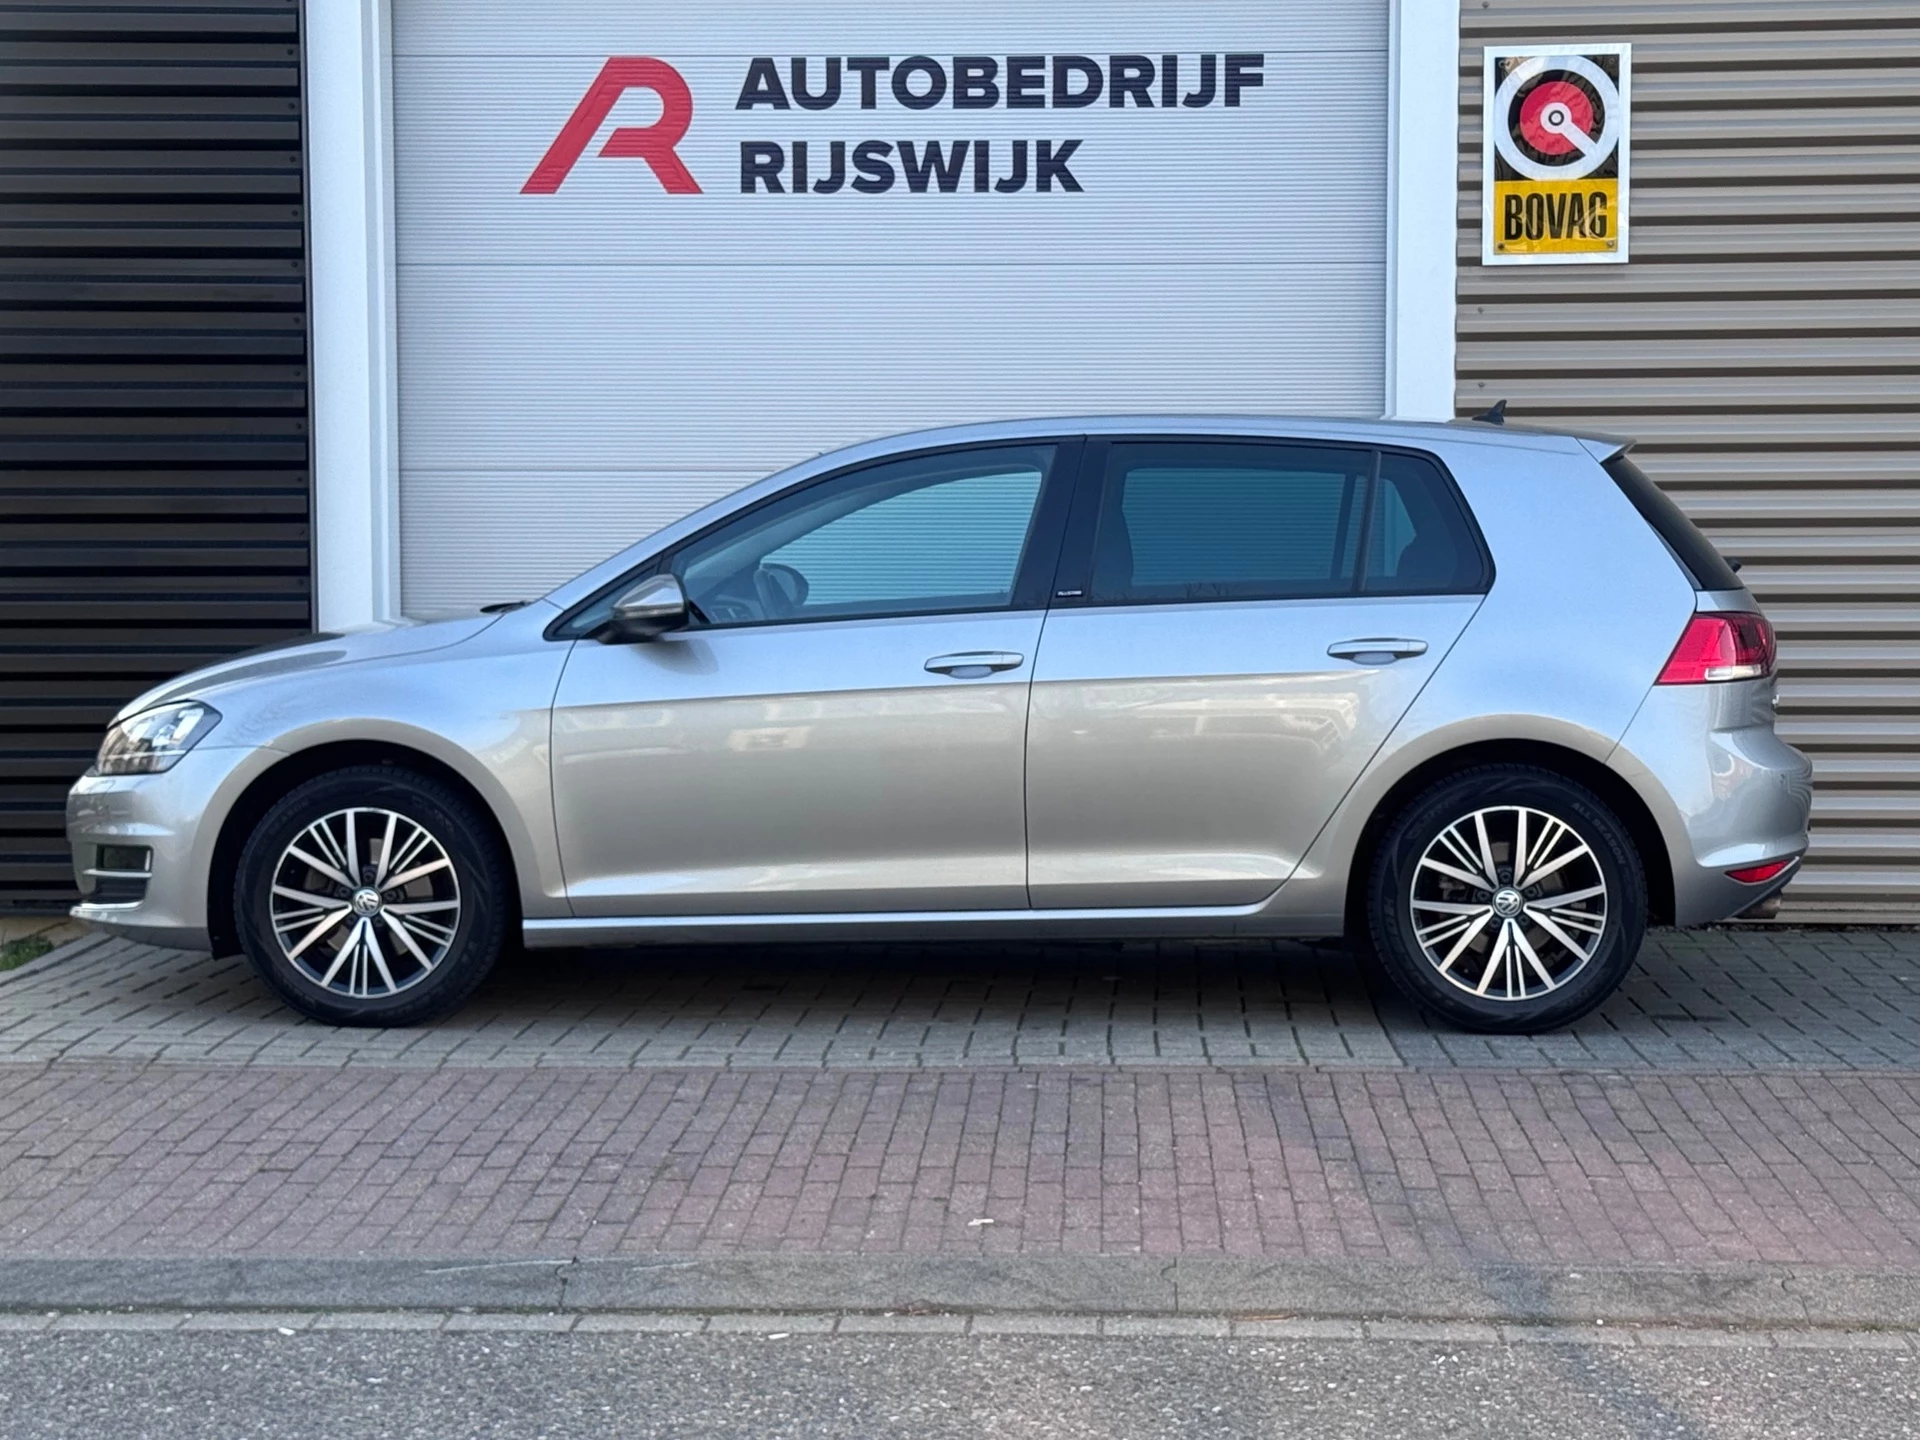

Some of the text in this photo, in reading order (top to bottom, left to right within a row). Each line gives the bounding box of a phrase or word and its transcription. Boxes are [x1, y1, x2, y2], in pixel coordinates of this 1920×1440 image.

[736, 54, 1264, 110] AUTOBEDRIJF
[741, 140, 1083, 193] RIJSWIJK
[1505, 191, 1607, 240] BOVAG
